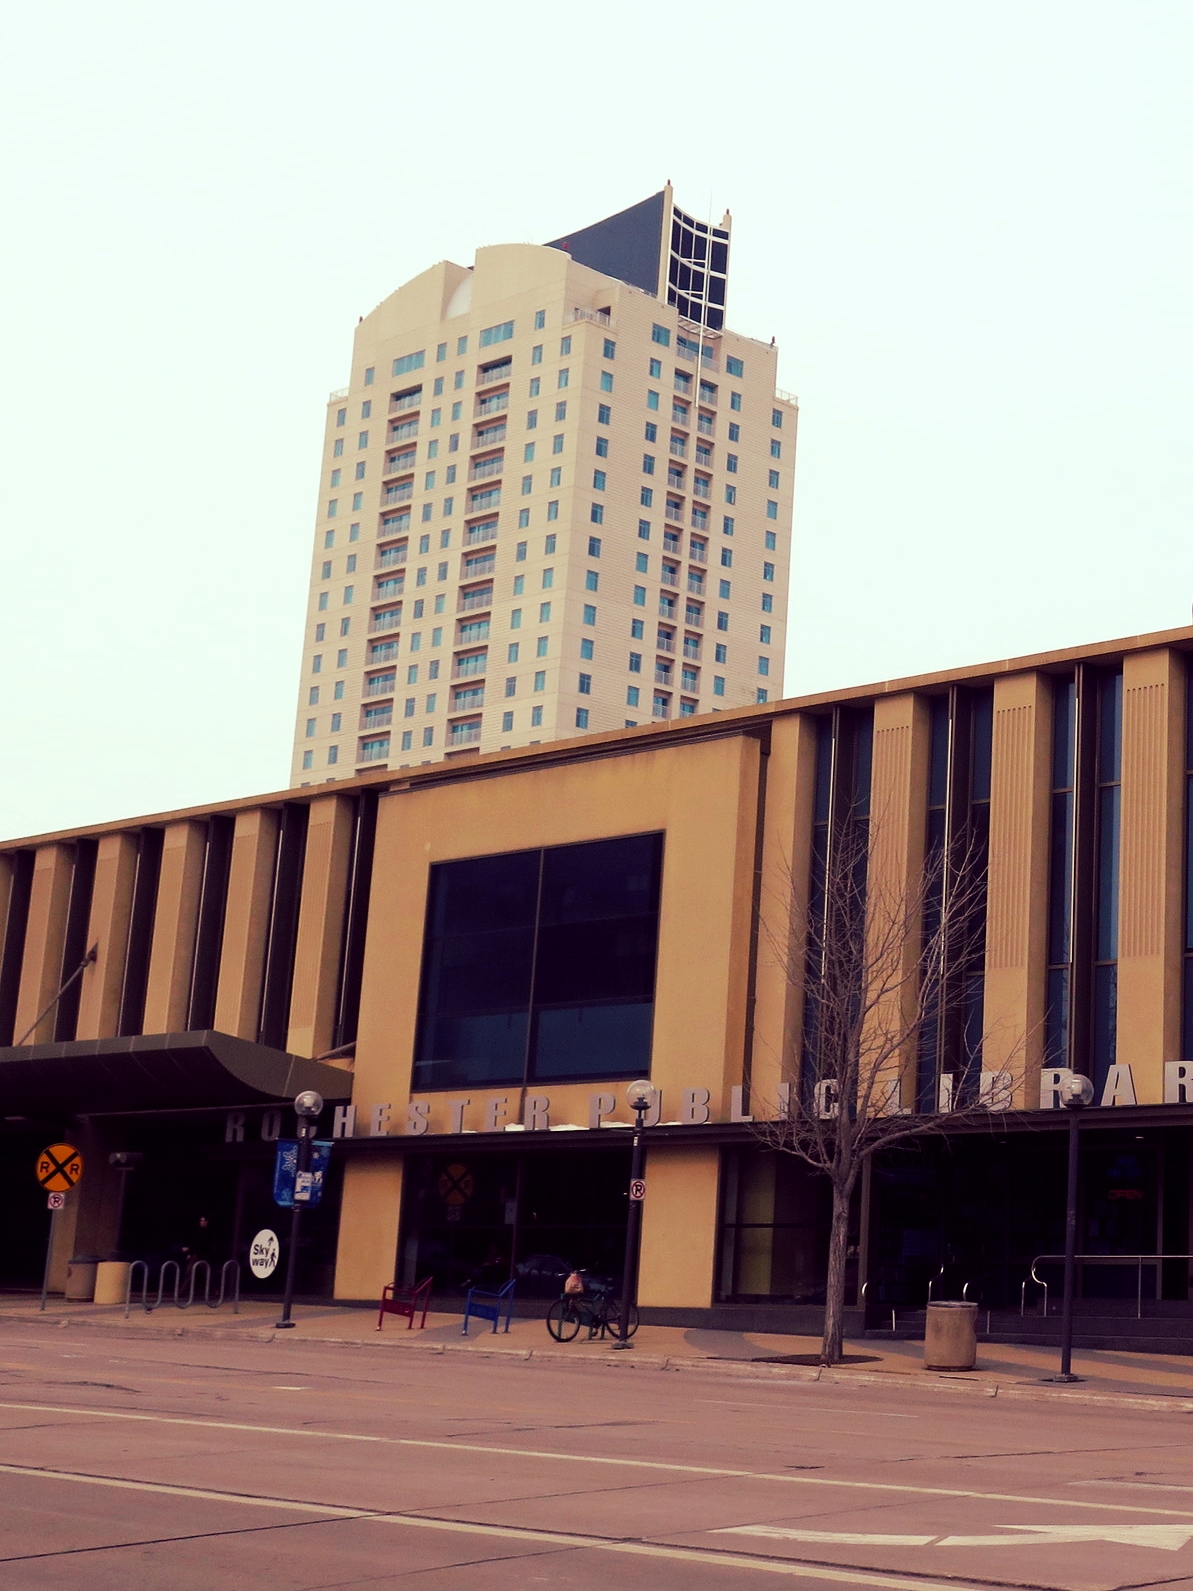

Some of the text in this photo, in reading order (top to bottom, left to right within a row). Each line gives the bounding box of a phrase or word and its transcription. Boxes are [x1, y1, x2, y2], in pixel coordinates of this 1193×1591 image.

[224, 1095, 550, 1143] ROCHESTER
[589, 1078, 840, 1129] PUBLIC
[39, 1162, 80, 1175] R R
[1107, 1189, 1143, 1200] OPEN
[253, 1244, 270, 1257] Sky
[252, 1258, 270, 1269] way
